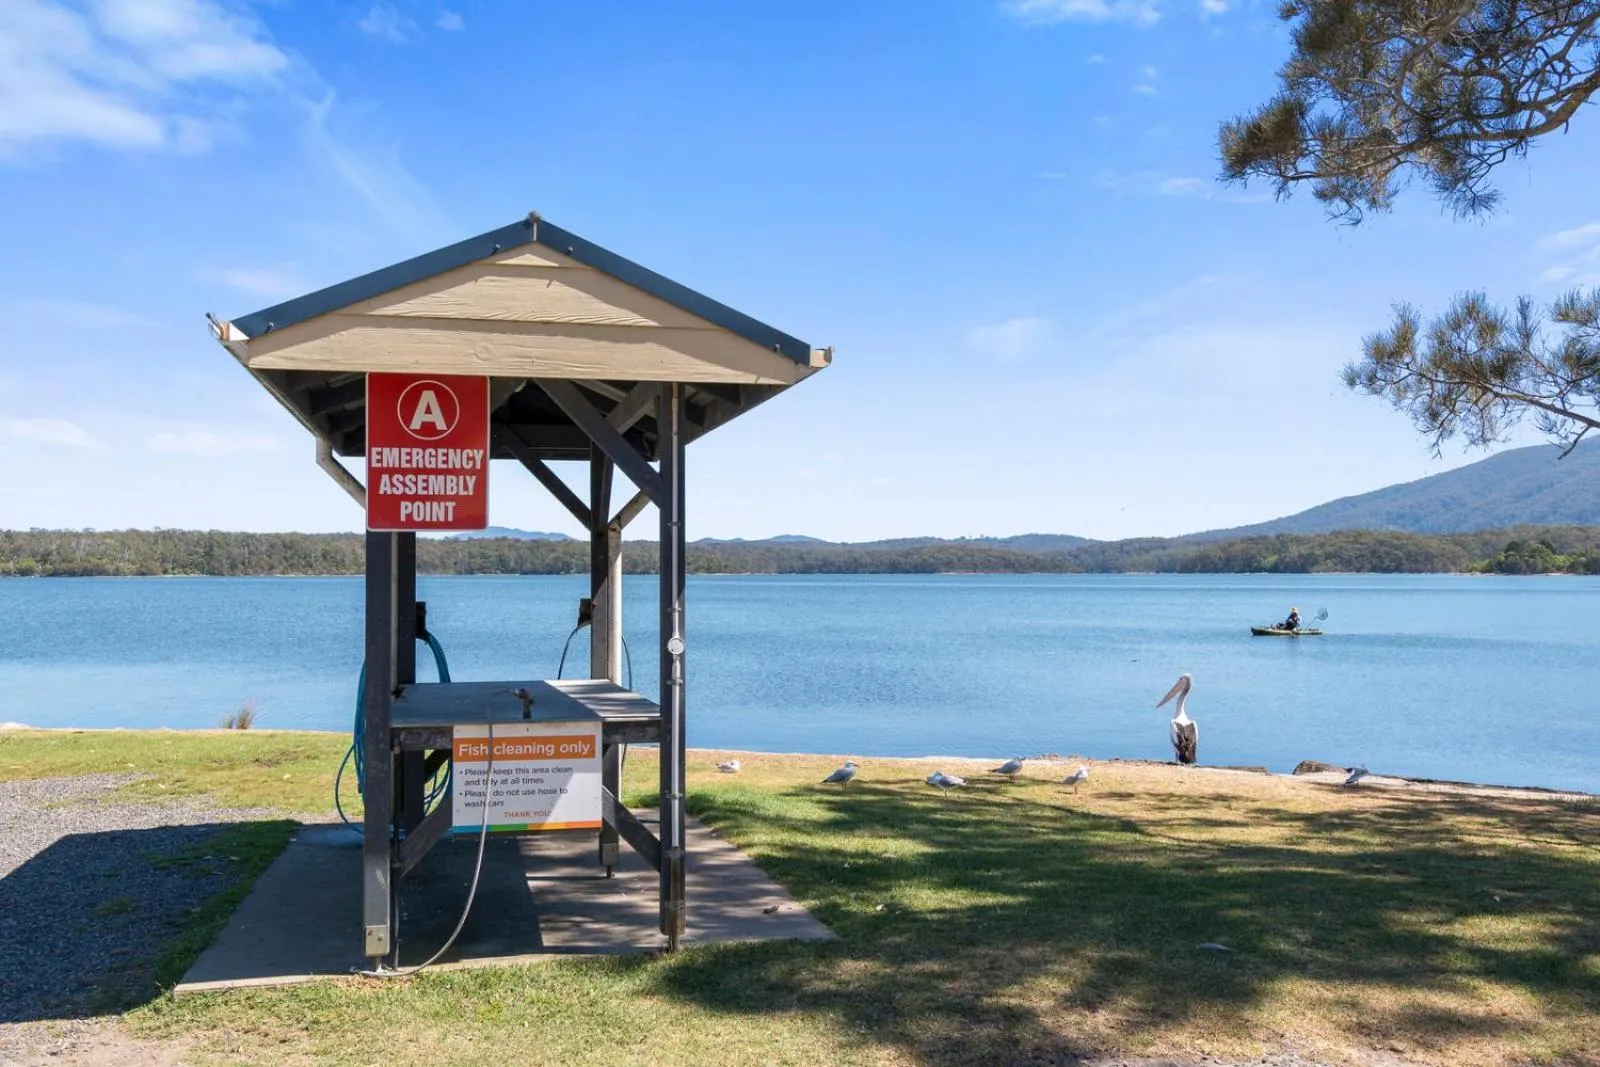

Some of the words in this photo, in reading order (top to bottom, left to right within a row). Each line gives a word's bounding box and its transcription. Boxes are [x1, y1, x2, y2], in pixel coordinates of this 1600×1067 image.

[409, 390, 448, 430] A
[370, 447, 484, 469] EMERGENCY
[379, 474, 477, 495] ASSEMBLY
[400, 501, 456, 522] POINT
[458, 743, 489, 757] Fish
[493, 742, 555, 756] cleaning
[560, 740, 591, 754] only
[493, 768, 513, 776] keep
[511, 777, 520, 785] all
[522, 777, 545, 785] times
[464, 790, 488, 798] Pleas
[493, 789, 504, 797] do
[559, 787, 569, 795] to
[504, 810, 531, 818] THANK
